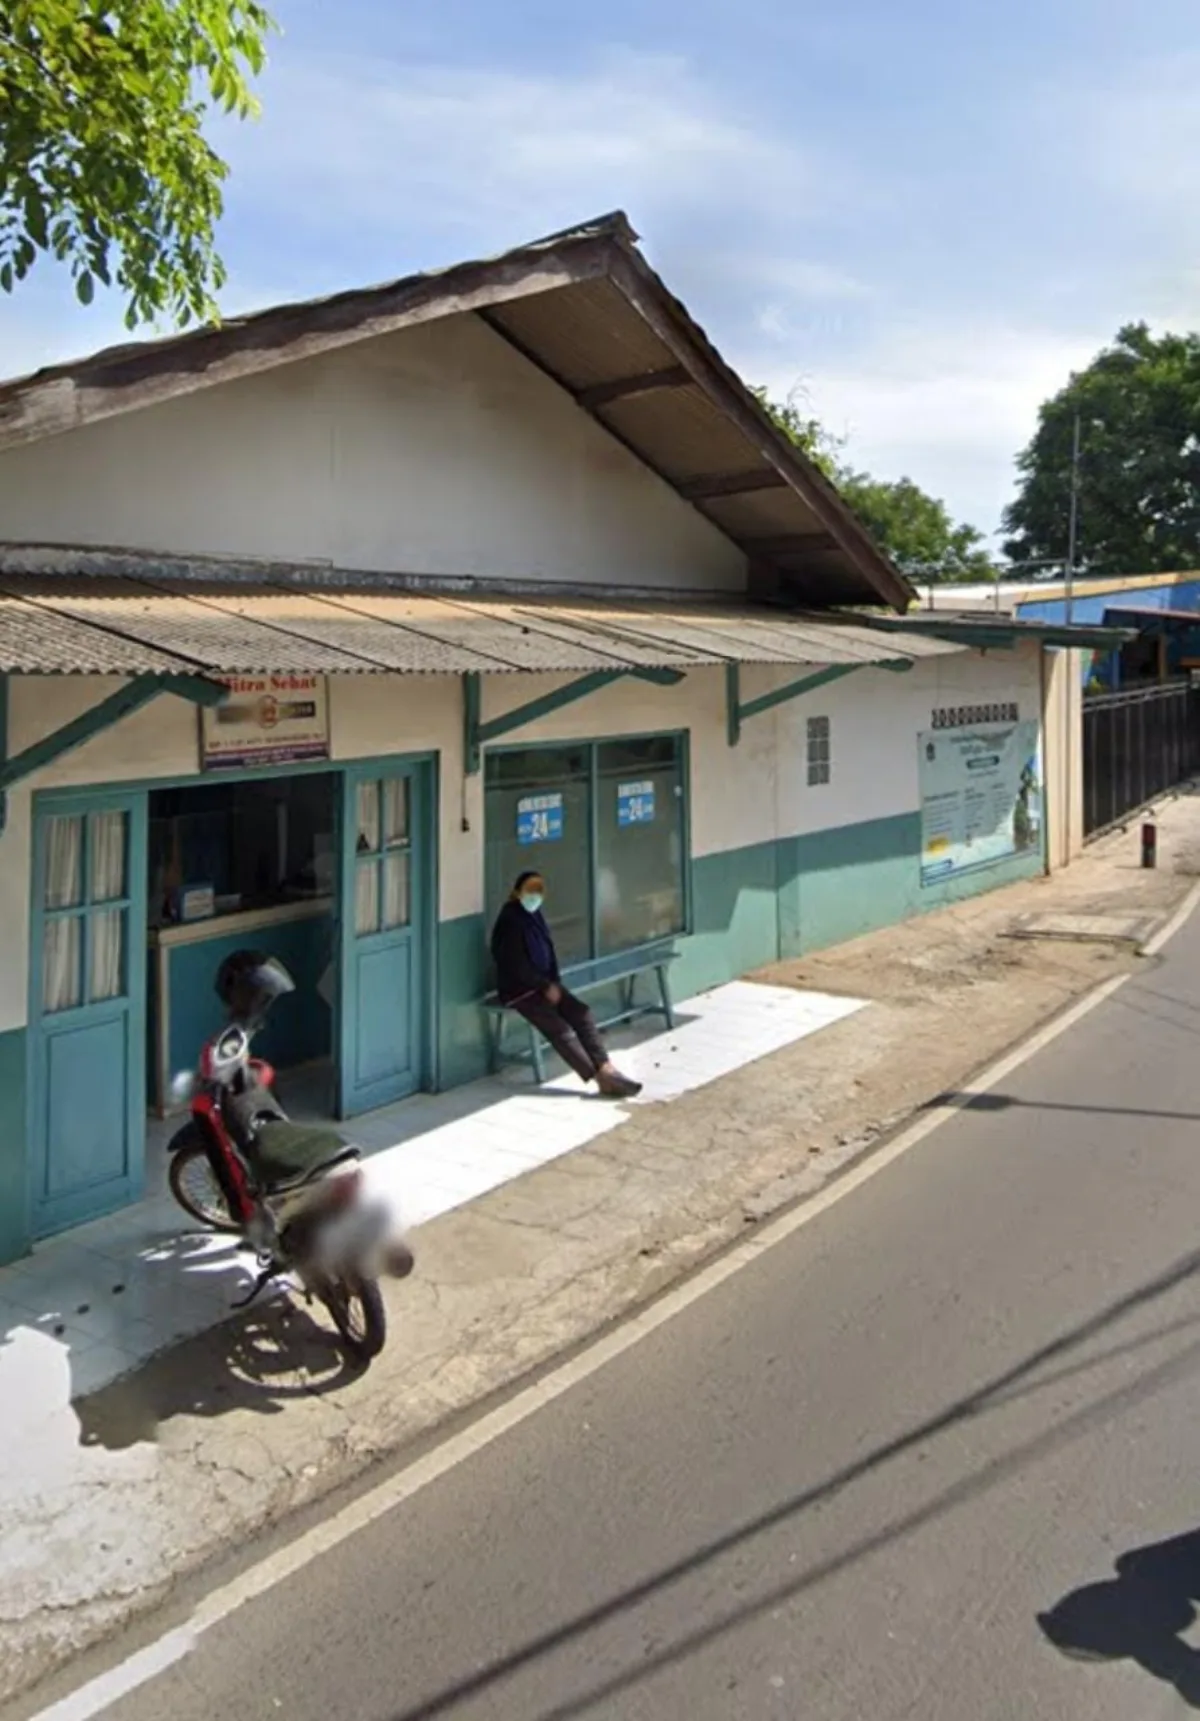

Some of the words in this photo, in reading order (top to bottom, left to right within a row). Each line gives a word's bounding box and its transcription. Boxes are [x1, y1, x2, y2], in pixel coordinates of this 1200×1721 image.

[270, 676, 317, 690] Sehat
[629, 797, 643, 820] 24
[531, 812, 548, 839] 24
